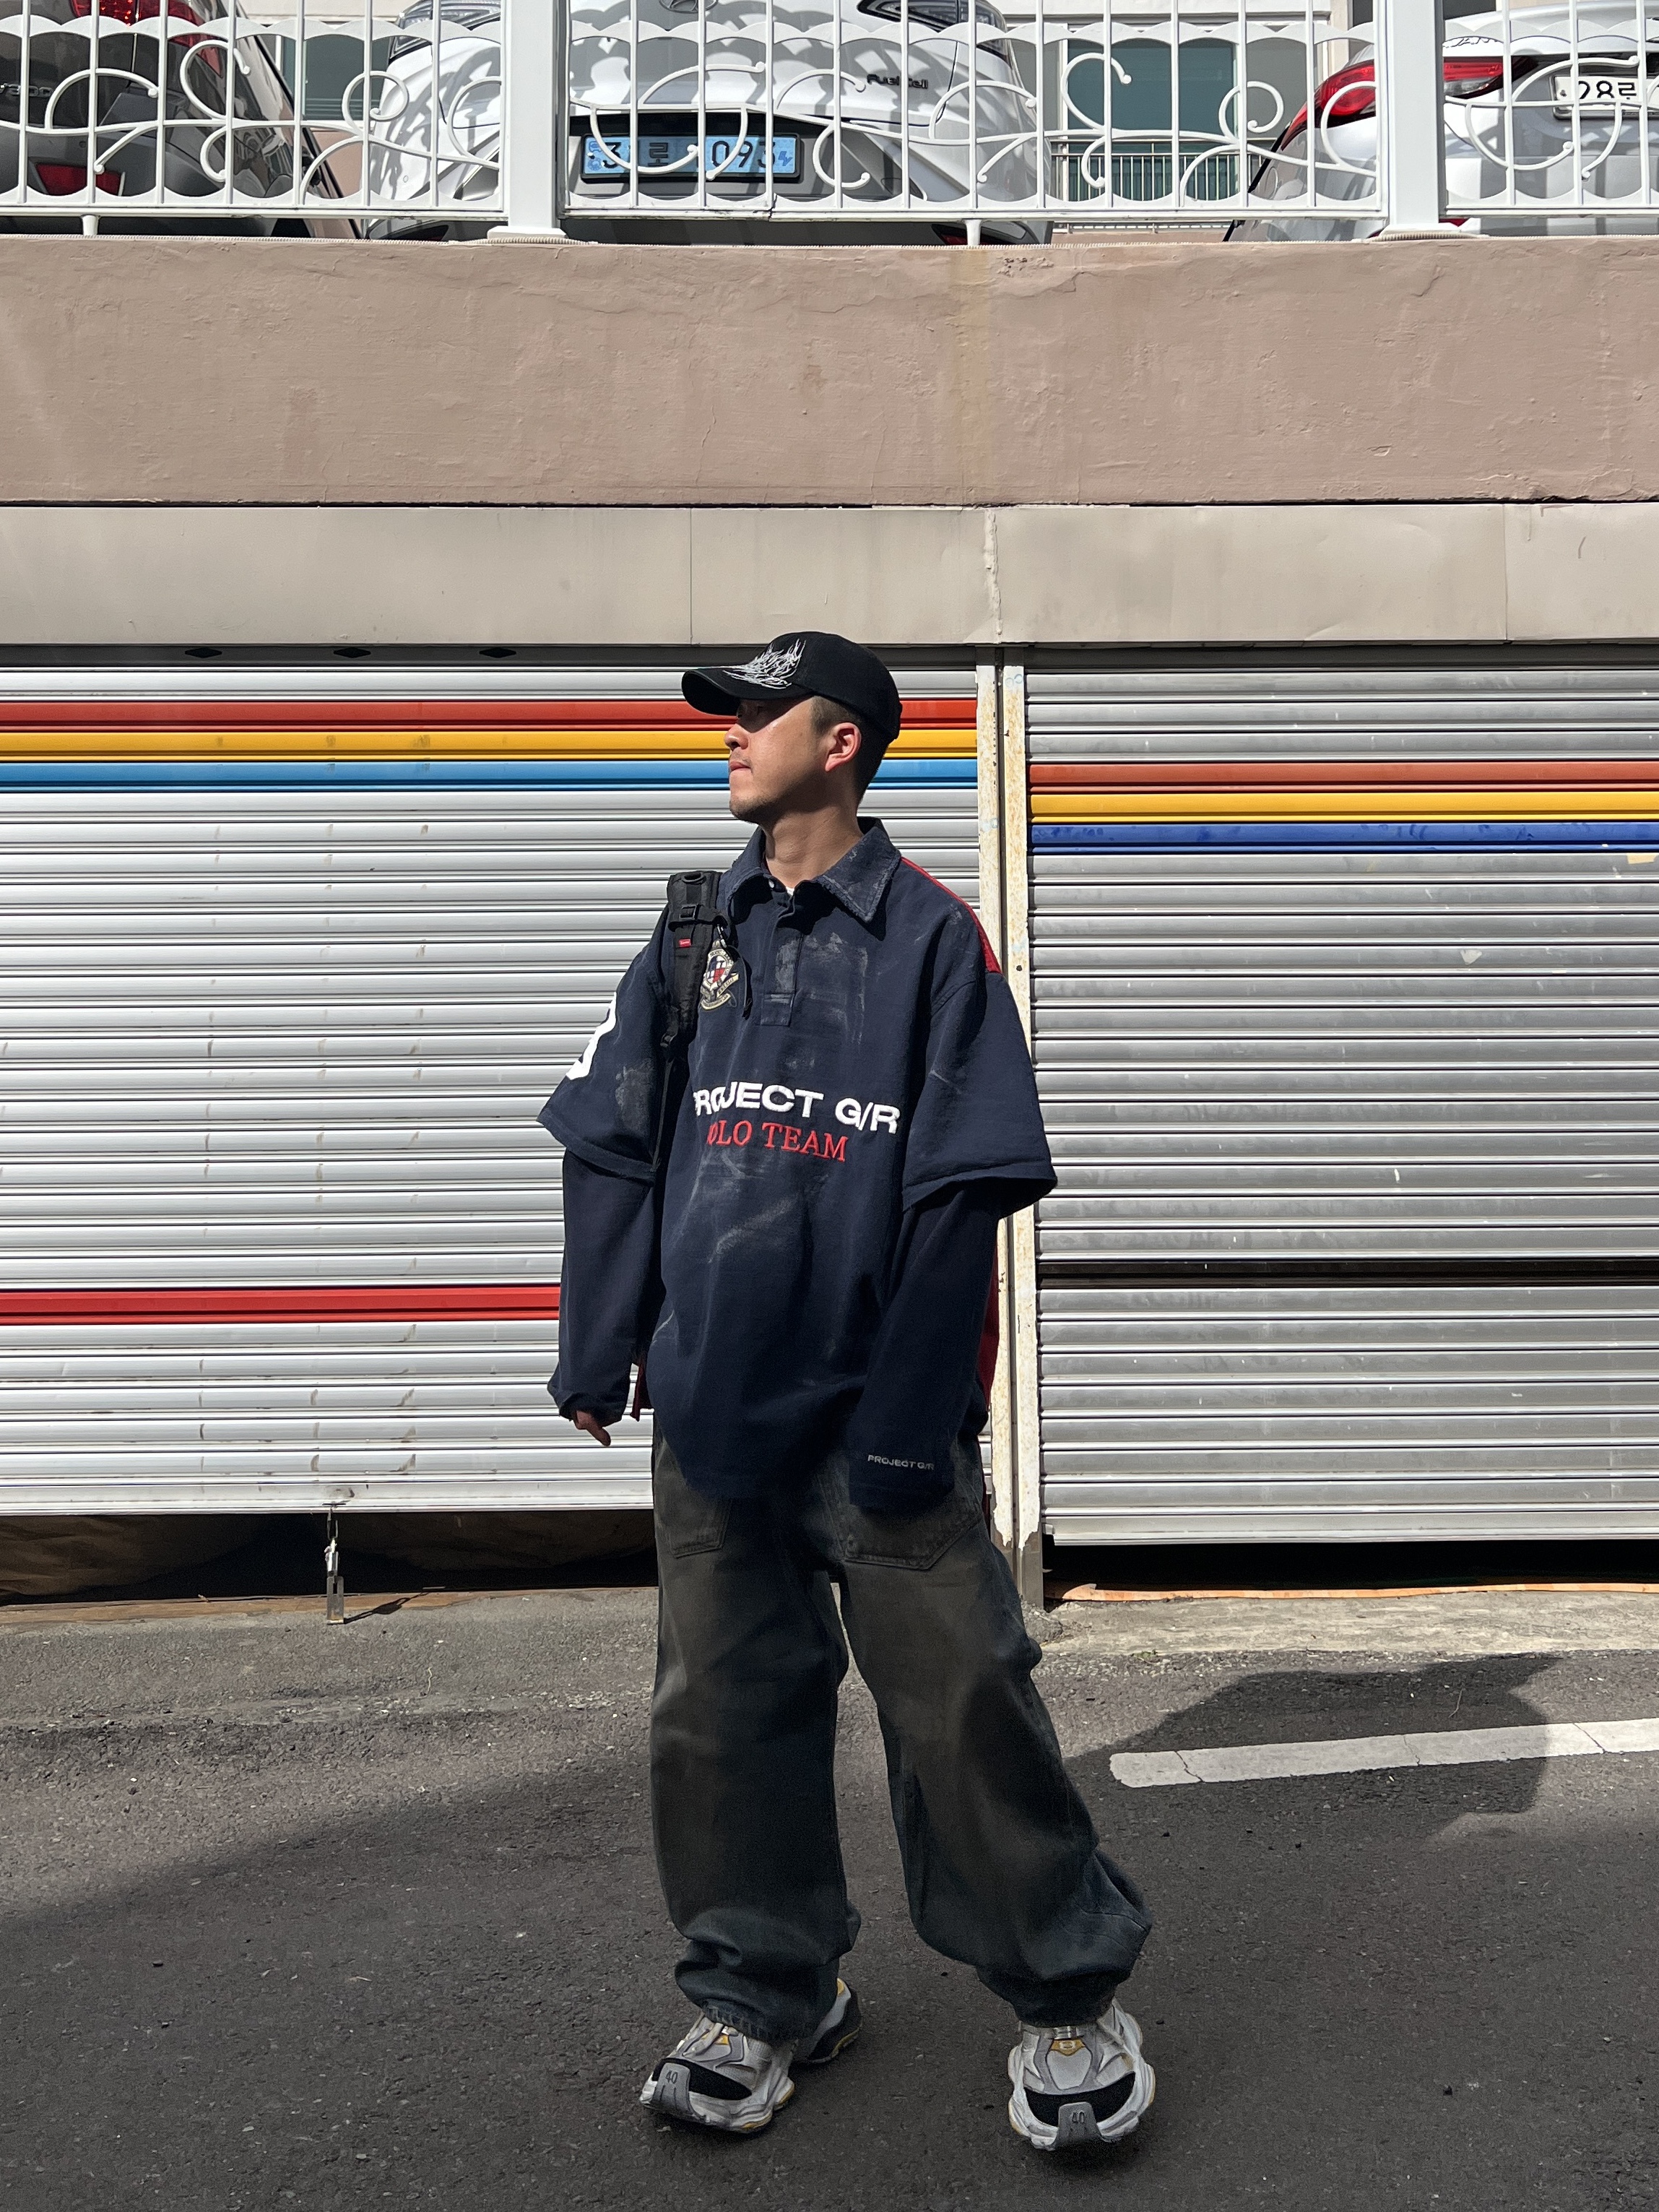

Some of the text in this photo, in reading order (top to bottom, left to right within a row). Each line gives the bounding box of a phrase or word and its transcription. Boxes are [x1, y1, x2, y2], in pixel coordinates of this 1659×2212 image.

[835, 1098, 901, 1134] G/R
[706, 1120, 849, 1162] OLO TEAM
[867, 1454, 917, 1469] PROJECT
[665, 2070, 678, 2084] 40
